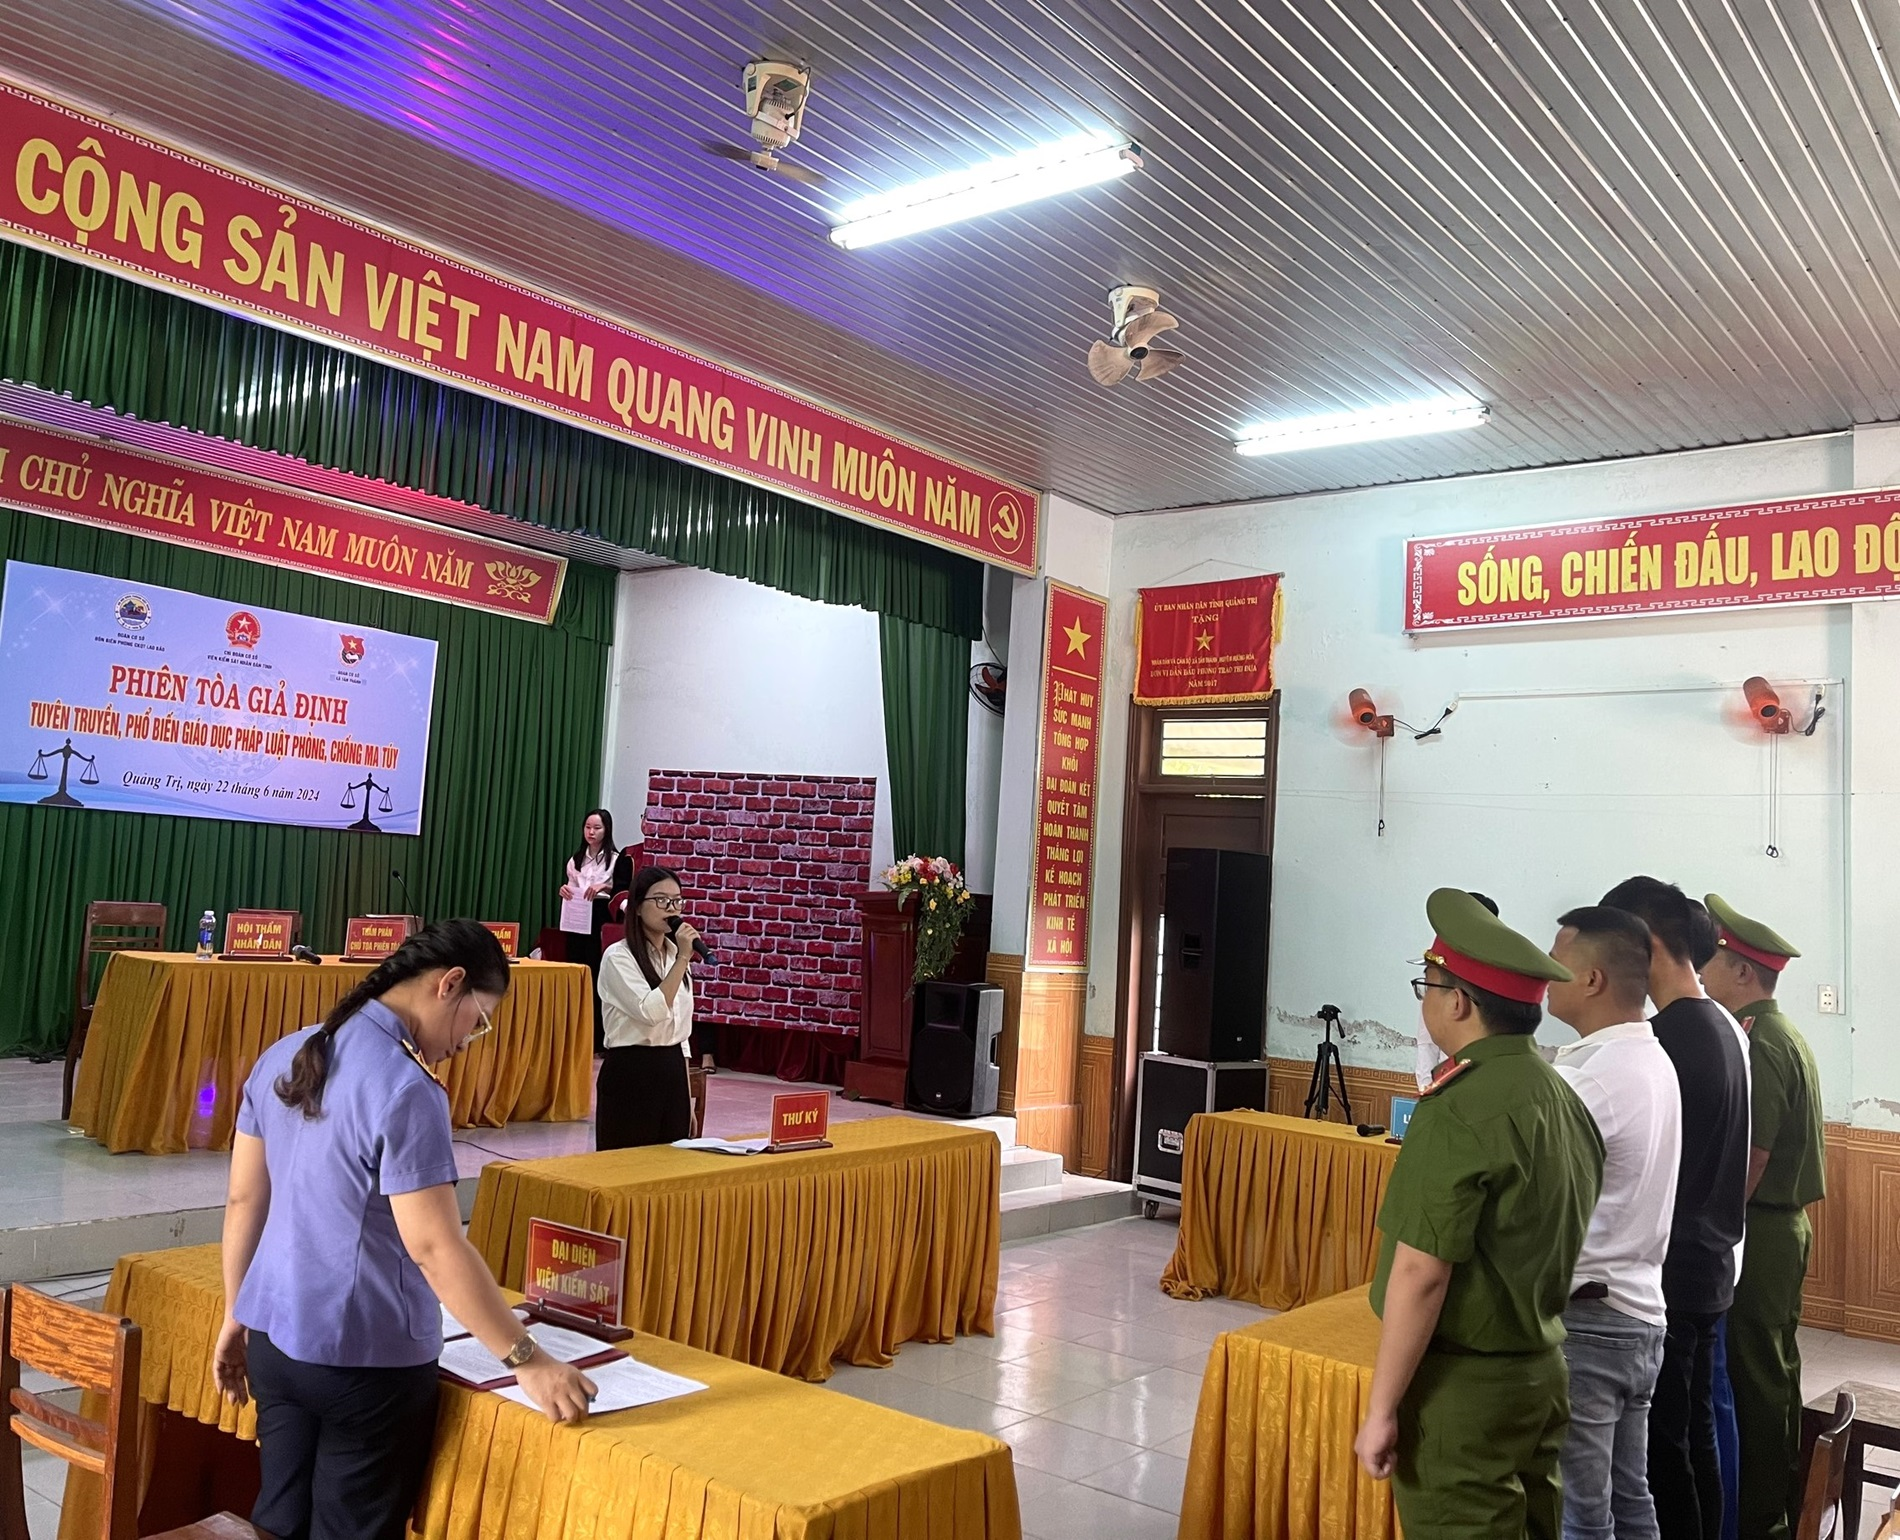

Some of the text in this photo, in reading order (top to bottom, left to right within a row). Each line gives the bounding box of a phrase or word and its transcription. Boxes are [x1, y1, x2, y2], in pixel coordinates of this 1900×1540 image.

[15, 136, 981, 538] CỘNG SẢN VIỆT NAM QUANG VINH MUÔN NĂM
[19, 452, 92, 500] CHỦ
[98, 473, 195, 527] NGHĨA
[209, 498, 272, 547] VIỆT
[278, 517, 339, 559] NAM
[342, 535, 417, 576] MUÔN
[420, 548, 474, 589] NĂM
[1456, 544, 1550, 606] SỐNG,
[1561, 531, 1662, 597] CHIẾN
[1674, 522, 1758, 587] ĐẤU,
[1771, 527, 1840, 583] LAO
[1176, 602, 1194, 610] NHÂN
[1195, 601, 1207, 609] DÂN
[1209, 599, 1224, 608] TỈNH
[1225, 597, 1246, 607] QUẢNG
[1191, 614, 1219, 624] TẶNG
[1188, 679, 1204, 688] NĂM
[108, 665, 349, 727] PHIÊN TÒA GIẢ ĐỊNH
[1080, 692, 1094, 708] HUY
[1053, 707, 1092, 731] SỨC MẠNH
[30, 699, 399, 769] TUYÊN TRUYỀN, PHỔ BIẾN GIÁO DỤC PHÁP LUẬT PHÒNG, CHỐNG MA TÚY
[1053, 727, 1089, 753] TỔNG HỢP
[1061, 753, 1079, 772] KHỐI
[122, 771, 320, 801] Quảng Trị, ngày 22 tháng 6 năm 2024
[1046, 776, 1091, 797] ĐẠI ĐOÀN KẾT
[1047, 797, 1088, 819] QUYẾT TÂM
[1043, 822, 1089, 841] HOÀN THÀNH
[1046, 842, 1084, 867] THẮNG LỢI
[1045, 864, 1082, 888] KẾ HOẠCH
[1043, 889, 1085, 909] PHÁT TRIỂN
[237, 921, 282, 935] HỘI THẨM
[378, 926, 394, 937] PHÁN
[1046, 912, 1076, 931] KINH TẾ
[233, 937, 282, 949] NHÂN DÂN
[1047, 937, 1073, 957] XÃ HỘI
[782, 1108, 818, 1126] THƯ KÝ
[552, 1239, 596, 1270] ĐẠI DIỆN
[536, 1266, 610, 1306] VIỆN KIỂM SÁT
